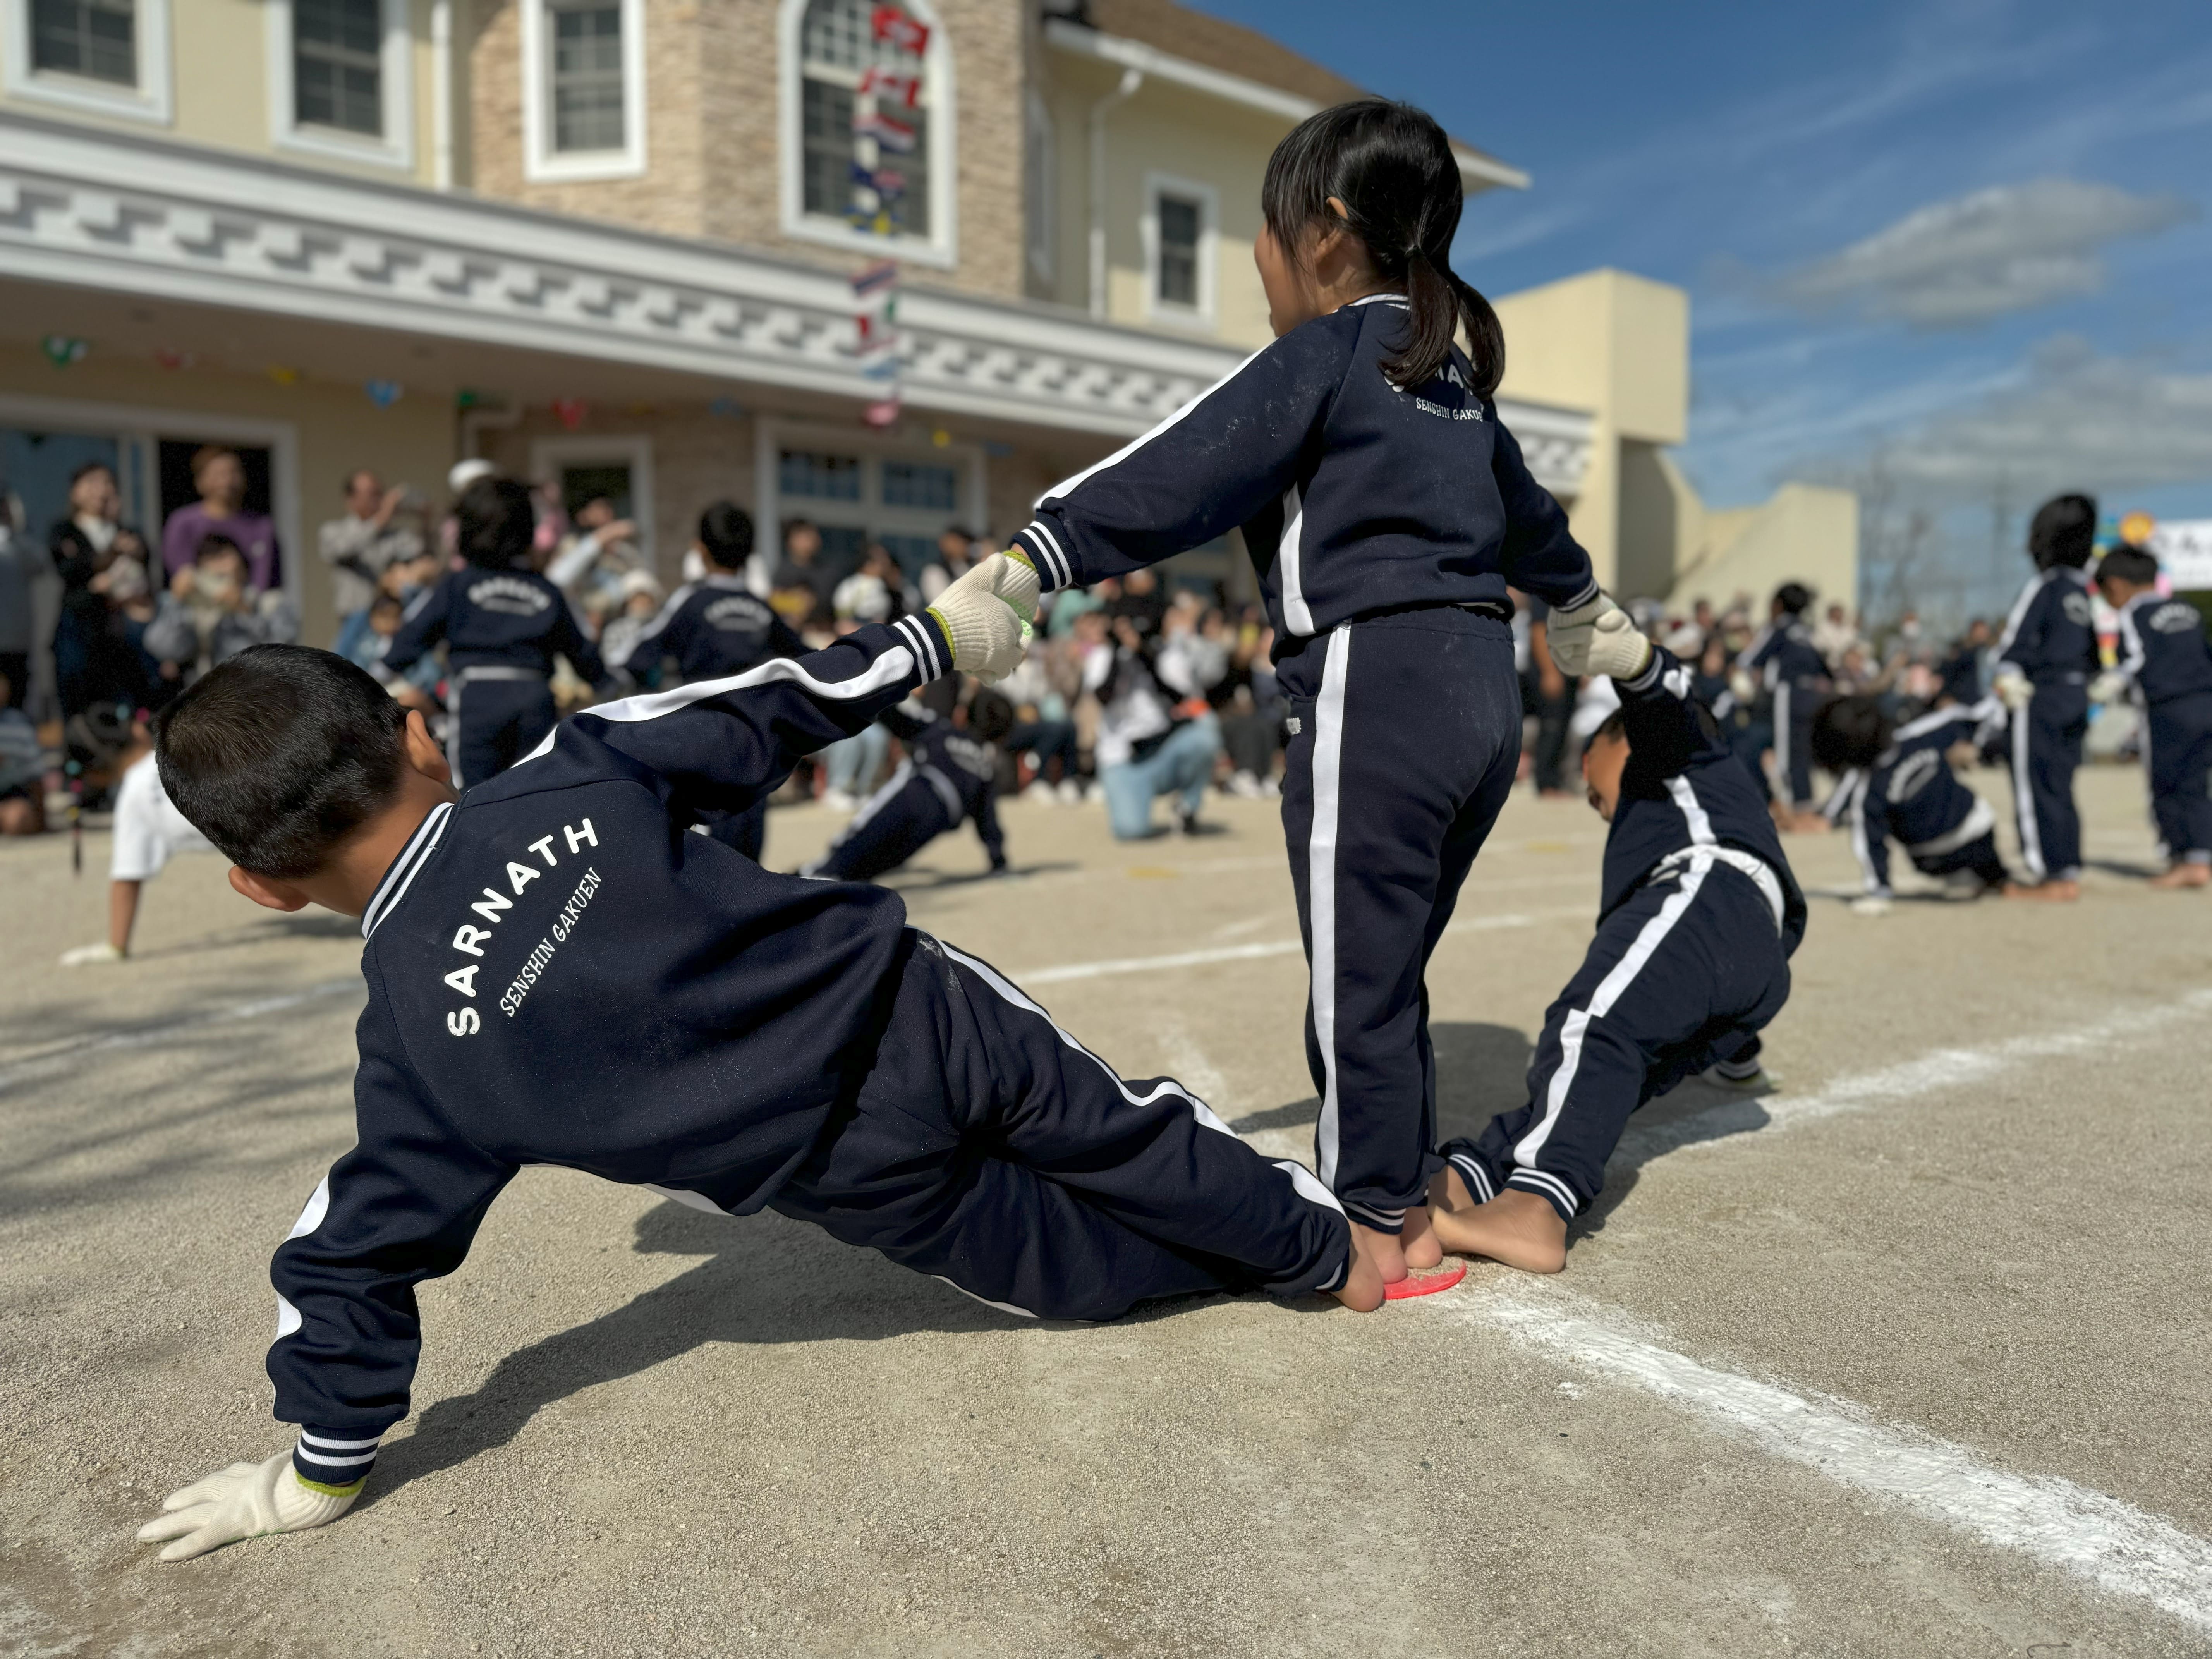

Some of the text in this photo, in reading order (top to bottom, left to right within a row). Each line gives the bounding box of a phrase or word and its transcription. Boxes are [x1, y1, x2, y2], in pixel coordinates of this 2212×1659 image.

[1416, 397, 1450, 419] SENSHIN
[444, 818, 598, 1036] SARNATH
[500, 867, 601, 1017] SENSHIN GAKUEN
